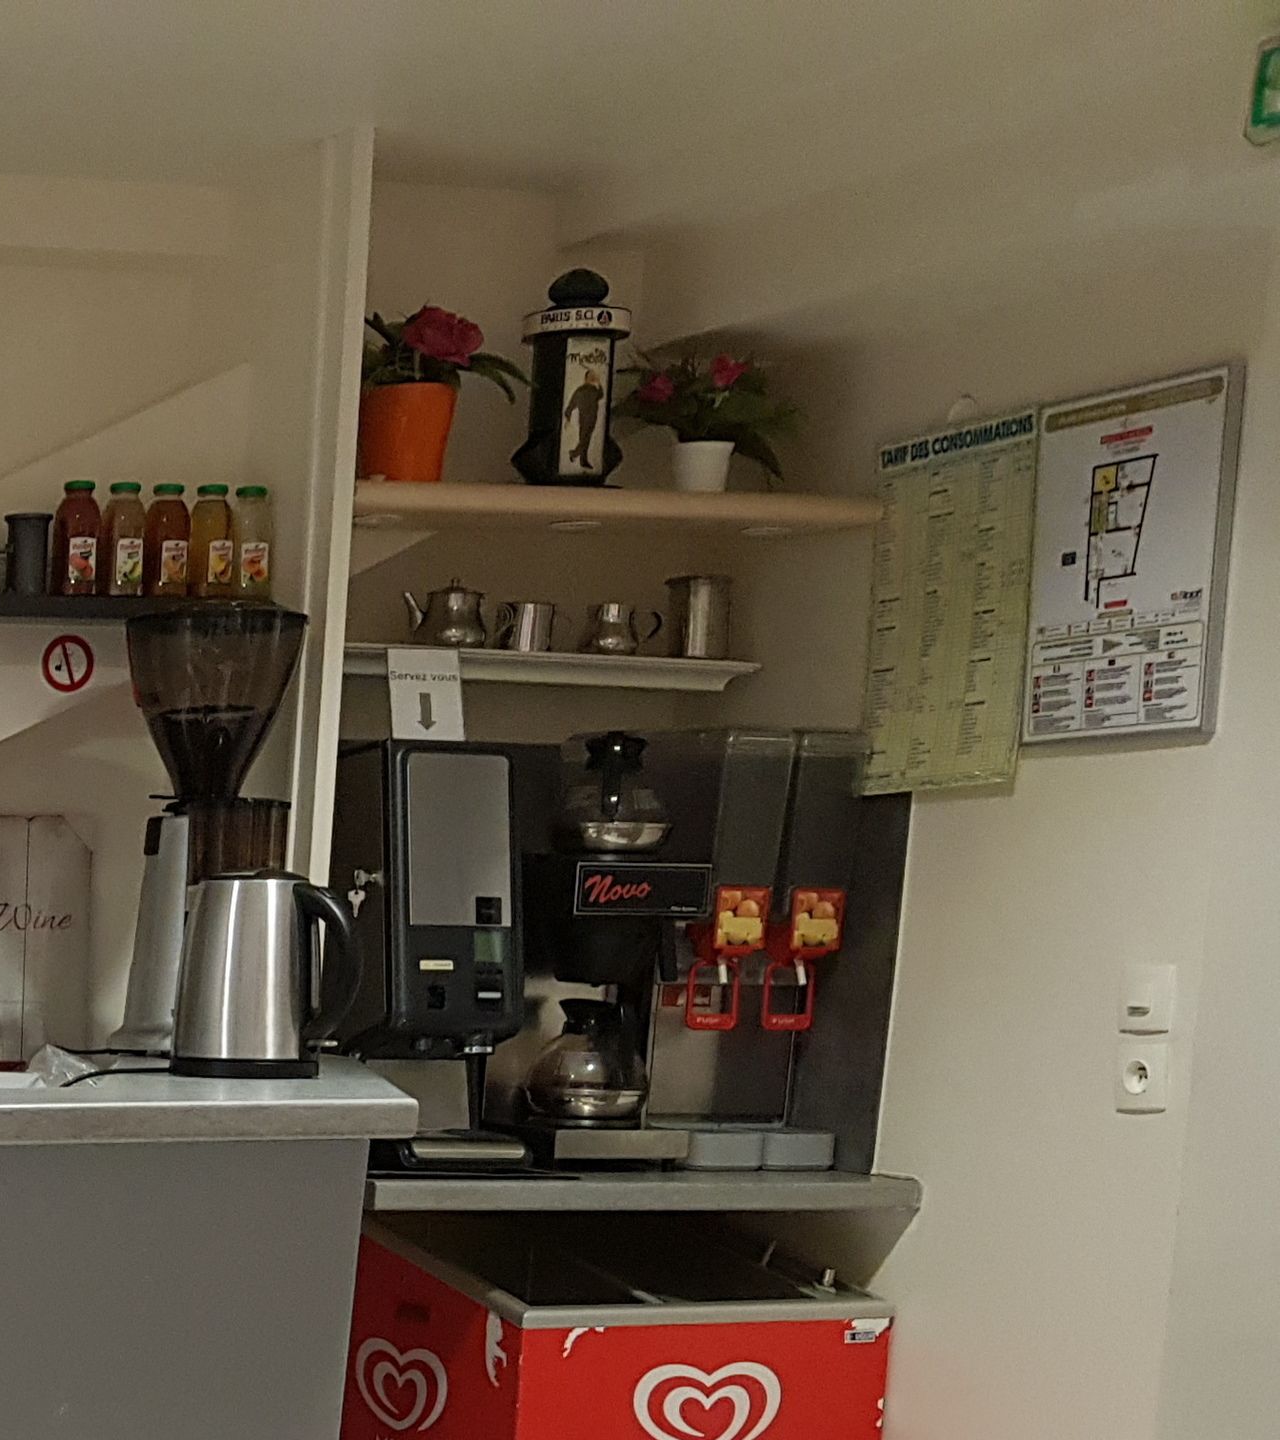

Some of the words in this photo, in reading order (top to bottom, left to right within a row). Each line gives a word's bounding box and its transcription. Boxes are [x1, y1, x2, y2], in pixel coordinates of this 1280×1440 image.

[881, 445, 908, 470] TARIF
[911, 439, 931, 462] DES
[931, 413, 1035, 456] CONSOMMATIONS
[389, 670, 427, 681] Servez
[430, 672, 458, 681] vous
[584, 874, 651, 903] Novo
